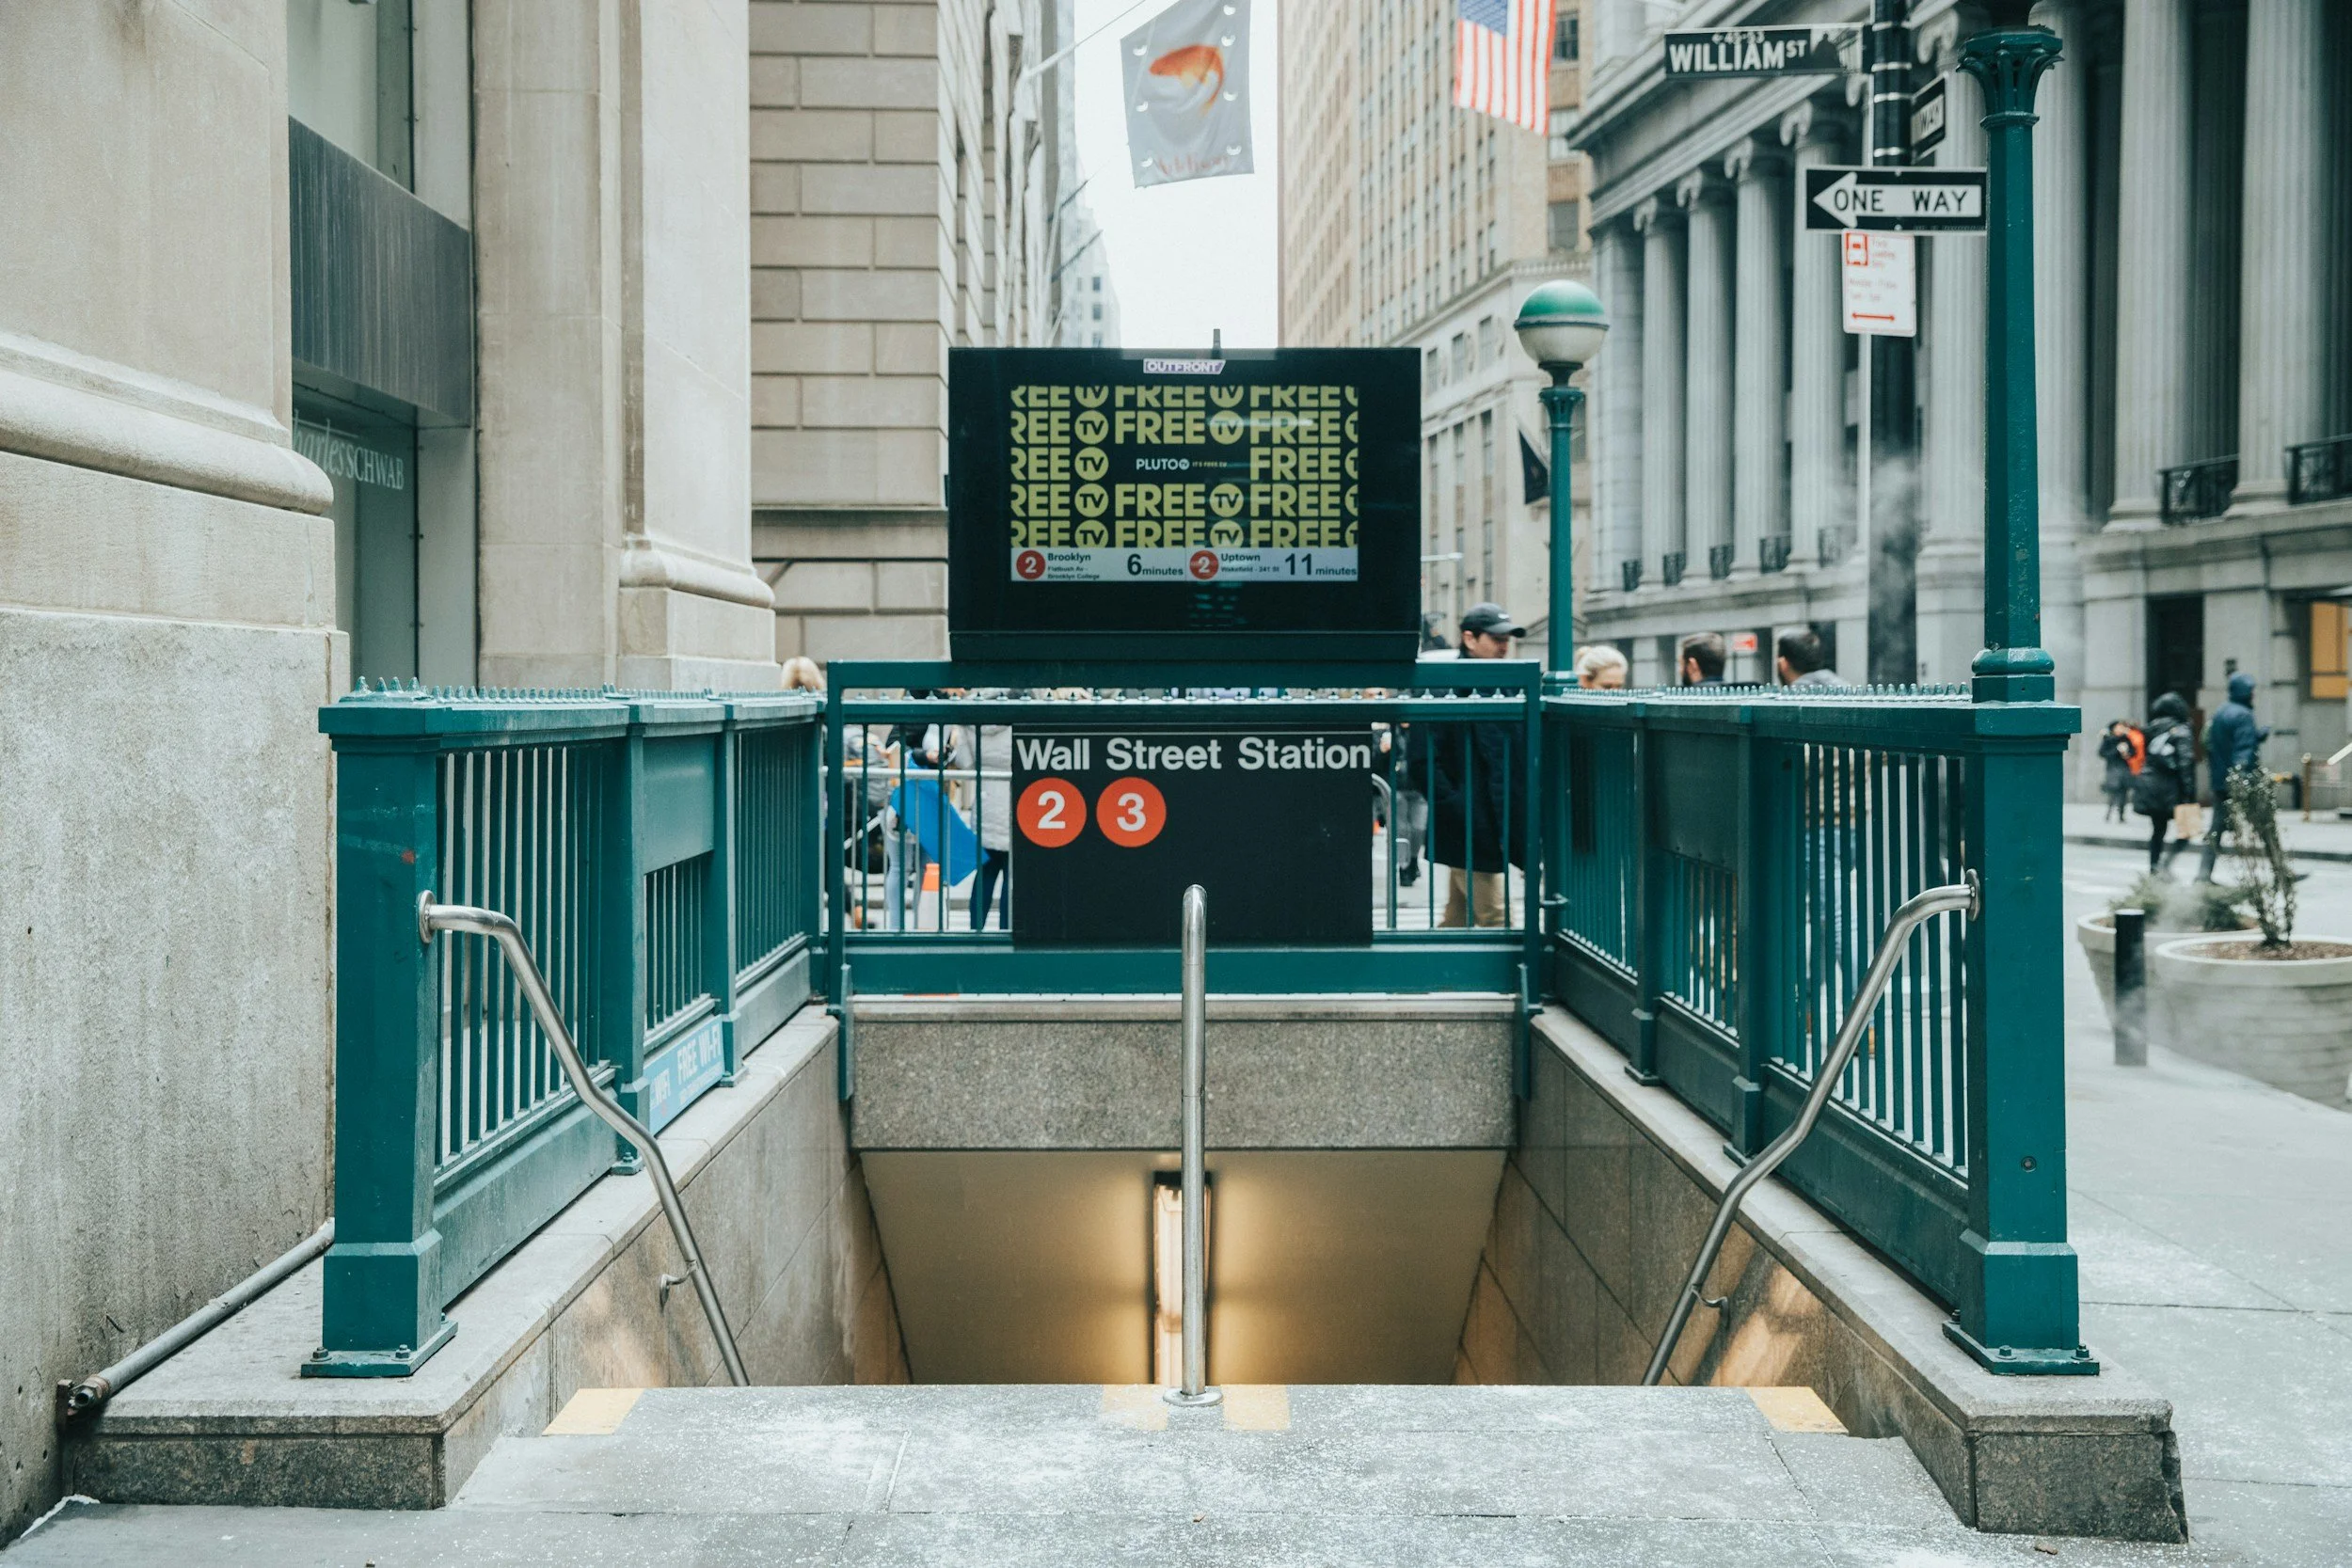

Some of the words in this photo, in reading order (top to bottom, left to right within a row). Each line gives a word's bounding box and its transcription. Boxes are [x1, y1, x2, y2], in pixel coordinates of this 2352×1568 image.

[1669, 40, 1785, 72] WILLIAM
[1786, 40, 1807, 58] ST
[1835, 189, 1884, 212] ONE
[1913, 190, 1967, 213] WAY
[1146, 360, 1221, 373] OUTFRONT
[1115, 410, 1206, 445] FREE
[1249, 410, 1341, 445] FREE
[292, 408, 344, 477] harles
[345, 443, 405, 490] SCHWAB
[1136, 458, 1179, 470] PLUTO
[1249, 447, 1341, 482] FREE
[1115, 483, 1206, 517] FREE
[1249, 483, 1341, 517] FREE
[1047, 552, 1091, 563] Brooklyn
[1127, 553, 1142, 577] 6
[1142, 566, 1184, 577] minutes
[1220, 553, 1261, 562] Uptown
[1284, 553, 1312, 576] 11
[1315, 566, 1358, 576] minutes
[1016, 738, 1090, 771] Wall
[1106, 736, 1222, 771] Street
[1237, 736, 1371, 771] Station
[1037, 790, 1066, 830] 2
[1117, 792, 1147, 832] 3
[676, 1038, 698, 1085] FREE
